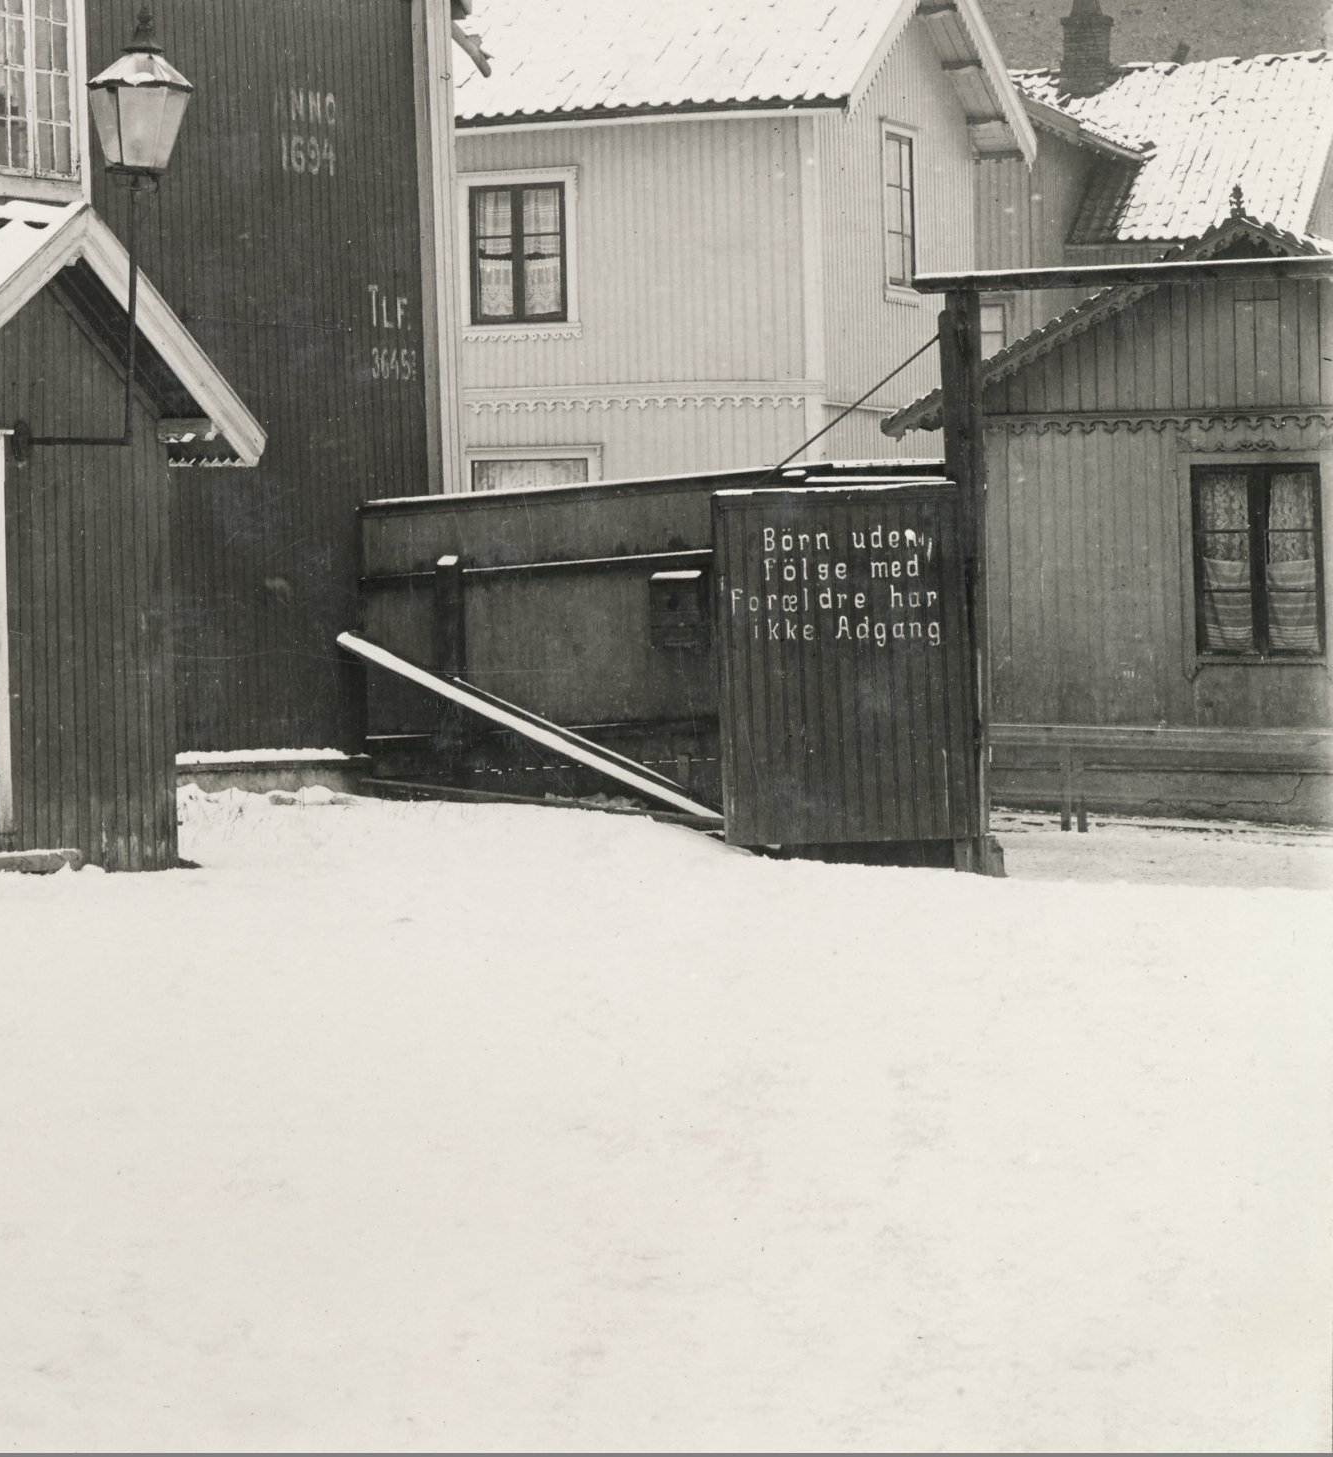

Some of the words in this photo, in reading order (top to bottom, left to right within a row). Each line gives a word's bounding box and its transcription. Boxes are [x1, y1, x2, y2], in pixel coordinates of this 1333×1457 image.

[281, 132, 336, 176] 1694
[763, 526, 830, 552] Börn
[870, 554, 920, 580] med
[731, 588, 866, 616] Forældre
[889, 584, 937, 609] har
[754, 617, 816, 642] ikke
[835, 614, 941, 647] Adgang
